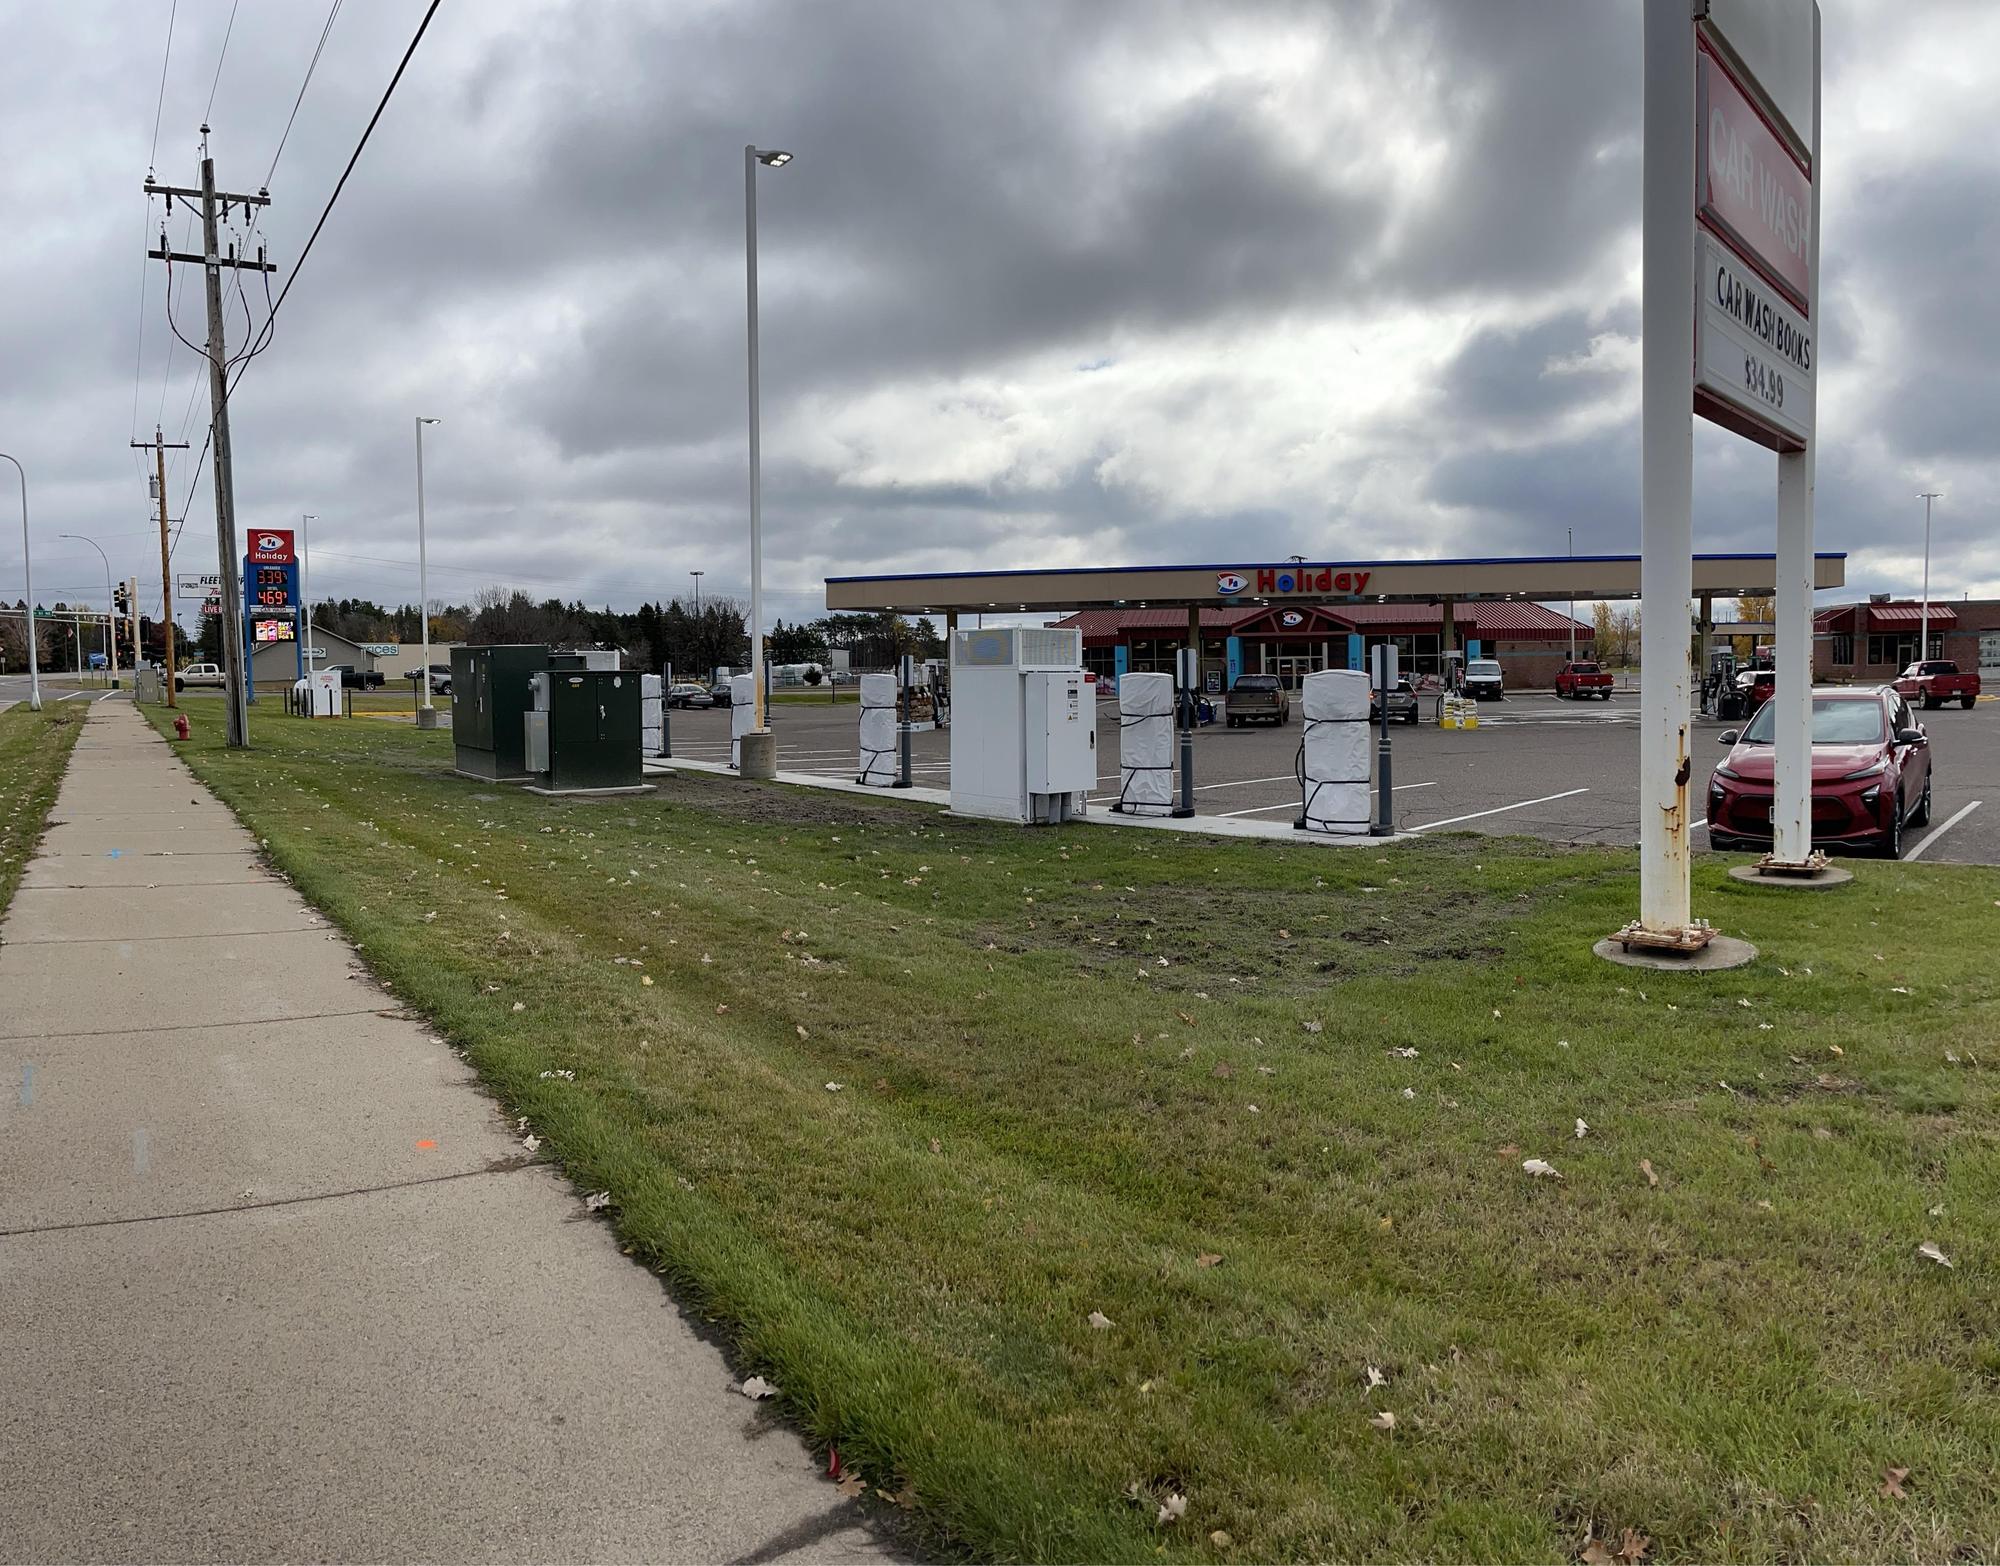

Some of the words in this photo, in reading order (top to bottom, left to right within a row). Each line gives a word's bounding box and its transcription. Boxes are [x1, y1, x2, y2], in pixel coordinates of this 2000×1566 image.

[1711, 108, 1754, 210] CAR
[1760, 161, 1809, 269] WASH
[1717, 266, 1742, 320] CAR
[1745, 288, 1776, 346] WASH
[1777, 315, 1811, 371] BOOKS
[1745, 354, 1784, 409] $34.99
[255, 552, 288, 561] Holiday
[1257, 568, 1370, 594] Holiday
